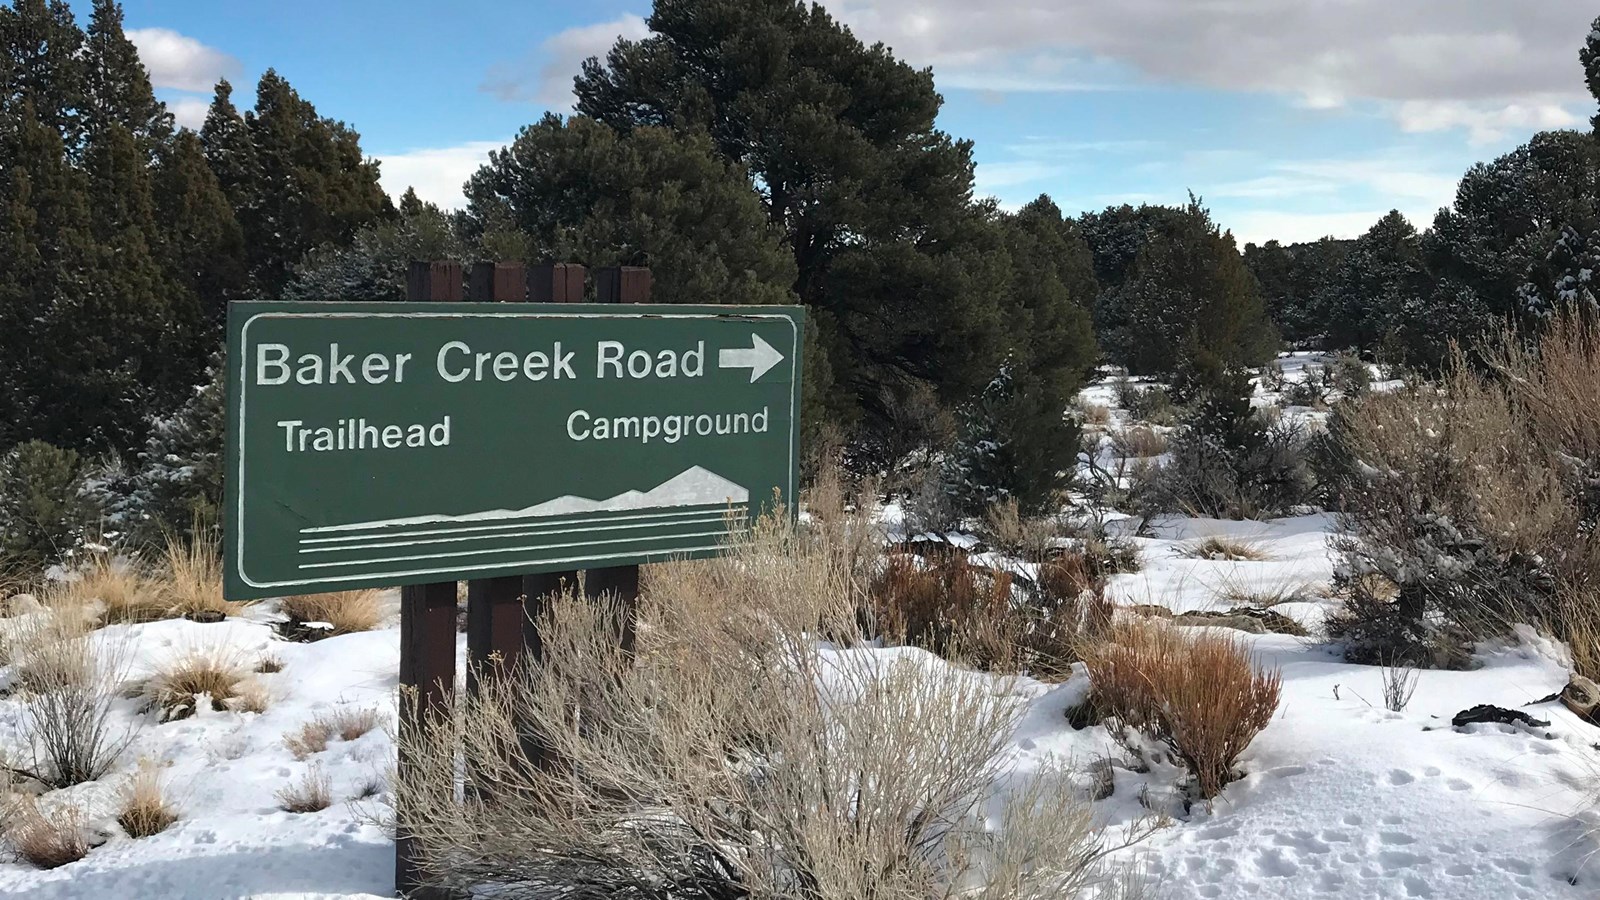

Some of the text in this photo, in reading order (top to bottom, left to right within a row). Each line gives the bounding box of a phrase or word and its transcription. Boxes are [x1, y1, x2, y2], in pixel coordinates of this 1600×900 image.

[256, 339, 706, 386] Baker Creek Road
[277, 415, 451, 453] Trailhead
[566, 406, 769, 444] Campground
